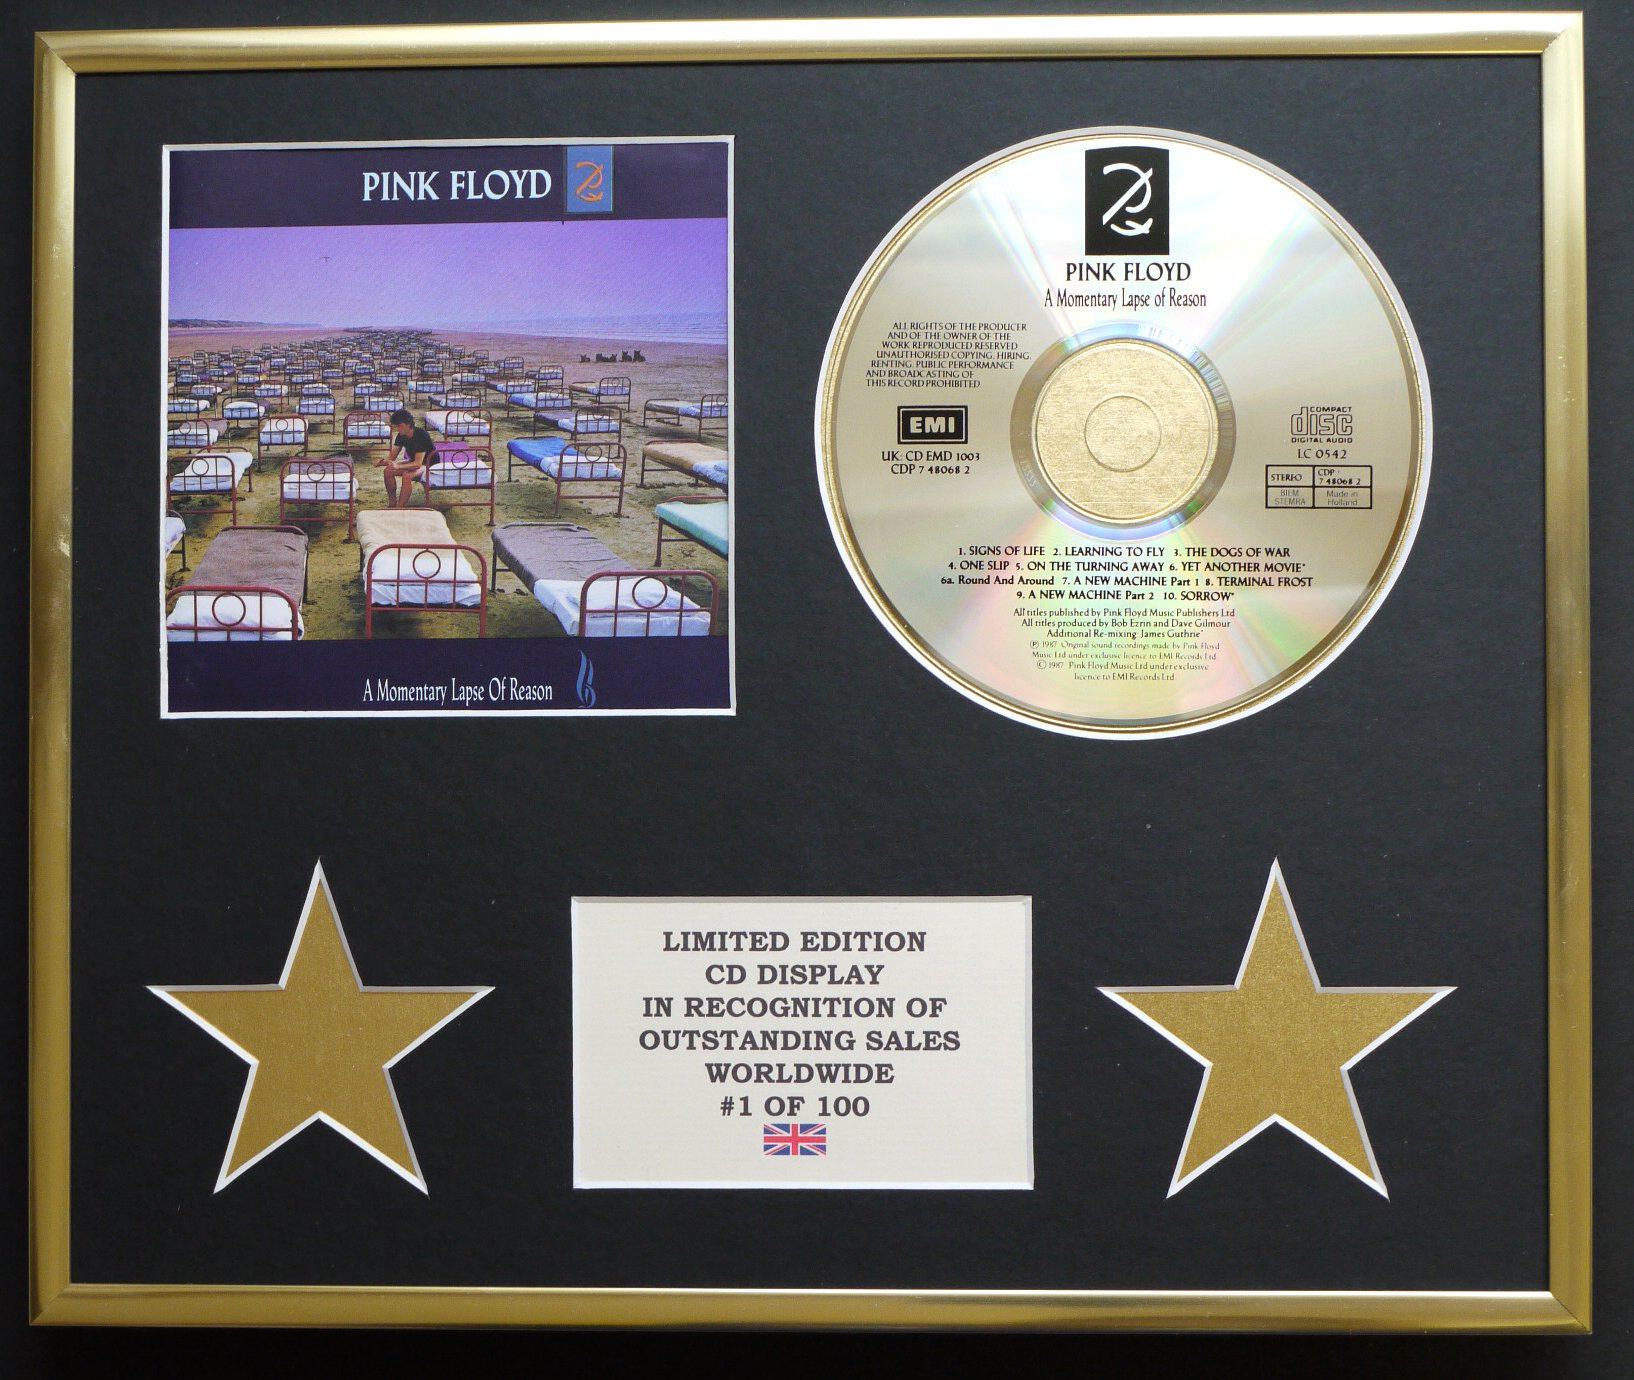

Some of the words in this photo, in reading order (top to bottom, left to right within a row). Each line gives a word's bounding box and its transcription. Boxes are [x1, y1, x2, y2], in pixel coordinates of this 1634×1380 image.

[362, 171, 440, 201] PINK
[450, 169, 551, 200] FLOYD
[1066, 262, 1116, 281] PINK
[1124, 262, 1191, 281] FLOYD
[1044, 288, 1053, 307] A
[1056, 288, 1117, 311] Momentary
[1121, 287, 1150, 311] Lapse
[1155, 286, 1166, 307] of
[1169, 287, 1207, 307] Reason
[893, 322, 908, 330] ALL
[910, 322, 943, 330] RIGHTS
[945, 322, 958, 330] OF
[959, 322, 977, 331] THE
[978, 322, 1027, 331] PRODUCER
[887, 332, 908, 340] AND
[909, 332, 922, 340] OF
[924, 332, 941, 340] THE
[943, 332, 977, 340] OWNER
[979, 332, 991, 340] OF
[993, 332, 1011, 340] THE
[882, 341, 910, 349] WORK
[912, 341, 973, 350] REPRODUCED
[974, 341, 1018, 350] RESERVED
[876, 350, 949, 359] UNAUTHORISED
[916, 360, 947, 369] PUBLIC
[949, 361, 1014, 370] PERFORMANCE
[866, 369, 886, 378] AND
[888, 370, 960, 378] BROADCASTING
[962, 370, 974, 378] OF
[866, 379, 886, 387] THIS
[887, 379, 924, 387] RECORD
[926, 379, 981, 388] PROHIBITED
[910, 416, 955, 433] EMI
[1291, 406, 1353, 436] disc
[905, 451, 923, 461] CD
[926, 450, 952, 461] EMD
[957, 453, 980, 461] 1003
[1297, 449, 1311, 458] LC
[1315, 449, 1347, 459] 0542
[891, 464, 915, 474] CDP
[919, 466, 924, 474] 7
[928, 465, 960, 474] 48068
[964, 466, 970, 474] 2
[1271, 473, 1302, 481] STEREO
[1280, 489, 1299, 497] BIEM
[1326, 490, 1348, 498] Made
[958, 548, 966, 556] 1.
[969, 546, 1001, 556] SIGNS
[1004, 546, 1021, 556] OF
[1023, 546, 1045, 556] LIFE
[1053, 548, 1061, 556] 2.
[1065, 547, 1122, 556] LEARNING
[1126, 547, 1142, 557] TO
[1146, 547, 1165, 557] FLY
[1174, 548, 1182, 557] 3.
[1185, 547, 1207, 557] THE
[1210, 547, 1242, 557] DOGS
[1245, 547, 1262, 557] OF
[1265, 548, 1290, 557] WAR
[948, 562, 957, 570] 4.
[960, 560, 984, 570] ONE
[988, 561, 1010, 570] SLIP
[1016, 562, 1024, 570] 5.
[1027, 561, 1045, 571] ON
[1049, 561, 1071, 571] THE
[1075, 561, 1128, 571] TURNING
[1132, 562, 1164, 571] AWAY
[1169, 563, 1178, 572] 6.
[1181, 562, 1201, 571] YET
[1204, 562, 1260, 572] ANOTHER
[941, 577, 955, 585] 6a.
[958, 575, 990, 585] Round
[993, 575, 1014, 585] And
[1017, 576, 1055, 585] Around
[1062, 577, 1070, 586] 7.
[1073, 576, 1081, 585] A
[1085, 576, 1110, 586] NEW
[1114, 576, 1167, 586] MACHINE
[1170, 577, 1190, 586] Part
[1205, 578, 1213, 586] 8.
[1216, 577, 1274, 587] TERMINAL
[1278, 577, 1313, 587] FROST
[1016, 591, 1025, 599] 9.
[1028, 590, 1036, 599] A
[1040, 590, 1065, 599] NEW
[1068, 590, 1121, 600] MACHINE
[1125, 591, 1145, 600] Part
[1163, 592, 1177, 600] 10.
[363, 678, 373, 701] A
[377, 678, 447, 706] Momentary
[451, 677, 484, 706] Lapse
[489, 676, 506, 701] Of
[510, 677, 553, 701] Reason
[662, 930, 790, 953] LIMITED
[800, 931, 927, 953] EDITION
[705, 964, 747, 986] CD
[757, 964, 885, 986] DISPLAY
[642, 997, 674, 1018] IN
[684, 996, 895, 1019] RECOGNITION
[905, 997, 947, 1018] OF
[639, 1030, 856, 1052] OUTSTANDING
[865, 1030, 961, 1052] SALES
[705, 1063, 895, 1085] WORLDWIDE
[720, 1096, 752, 1117] #1
[764, 1096, 805, 1117] OF
[818, 1096, 870, 1118] 100
